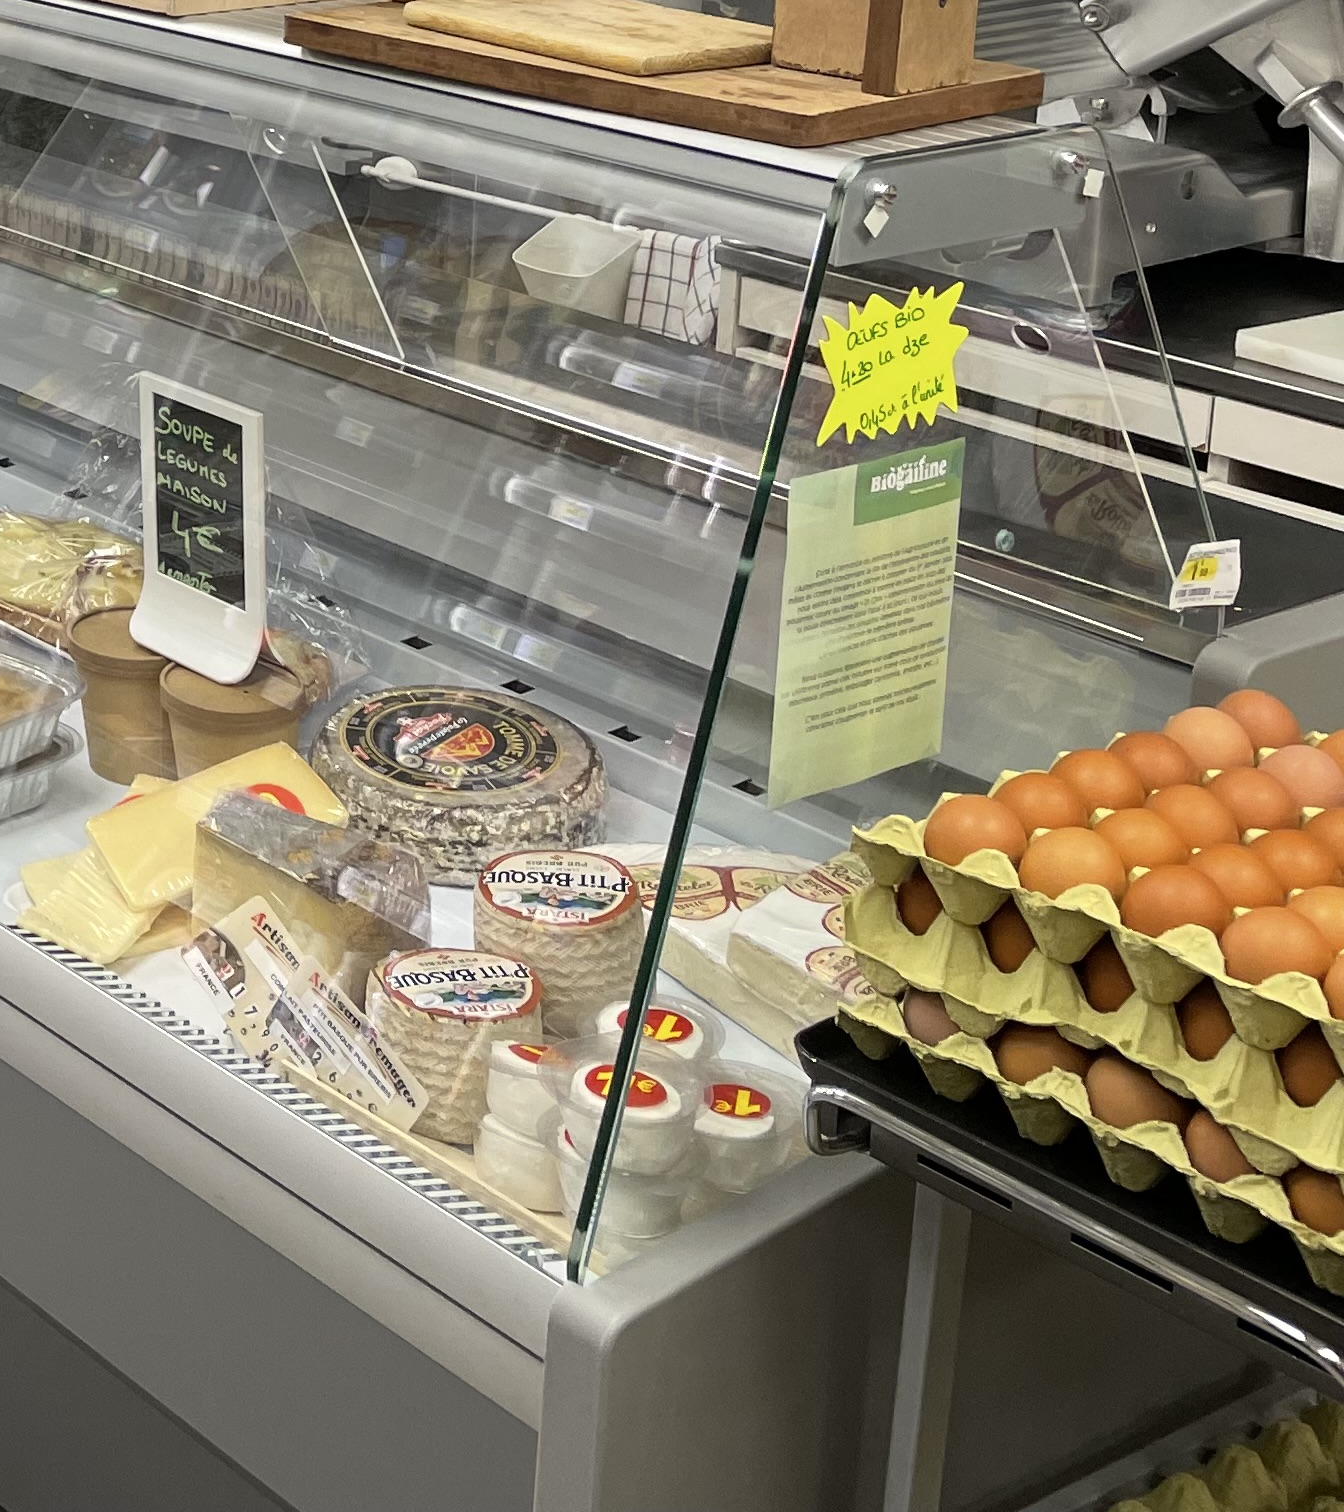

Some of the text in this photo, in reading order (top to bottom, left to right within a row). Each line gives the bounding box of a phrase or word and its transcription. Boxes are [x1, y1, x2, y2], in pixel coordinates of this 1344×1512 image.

[155, 407, 238, 465] SOUPE de
[157, 441, 227, 488] LEGUMES
[157, 472, 227, 515] MAISON
[496, 756, 520, 772] DE
[484, 870, 574, 887] BASQUE
[525, 859, 588, 868] PUR BREBIS
[526, 906, 586, 922] ISTARA
[250, 912, 301, 971] Artisan
[195, 961, 221, 997] FRANCE
[390, 968, 476, 989] BASQUE
[308, 972, 361, 1030] Artisan
[454, 1002, 518, 1016] ISTARA
[280, 1033, 307, 1066] FRANCE
[327, 1020, 355, 1055] BASQUE
[354, 1054, 368, 1071] PUR
